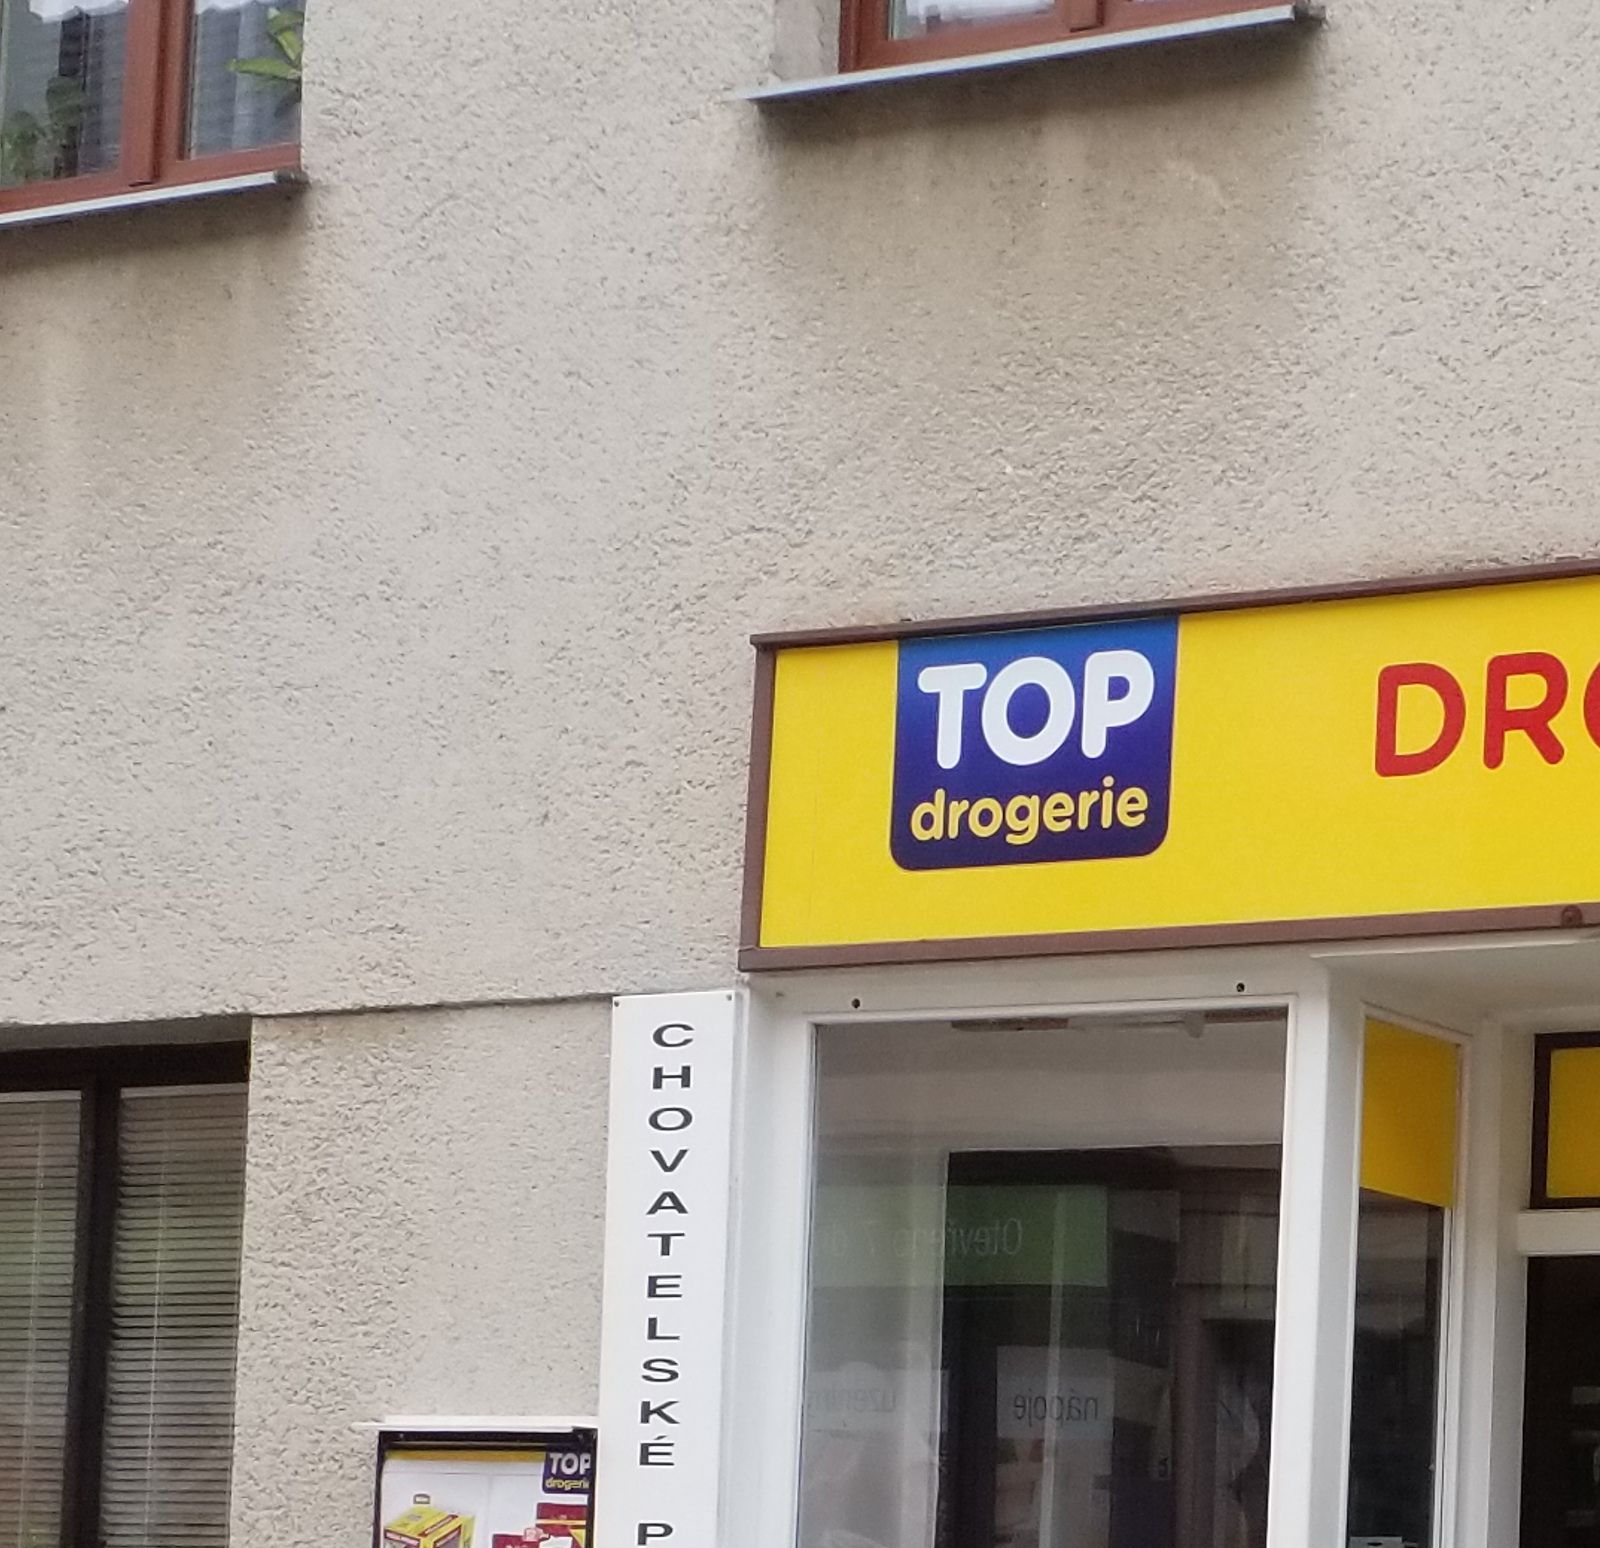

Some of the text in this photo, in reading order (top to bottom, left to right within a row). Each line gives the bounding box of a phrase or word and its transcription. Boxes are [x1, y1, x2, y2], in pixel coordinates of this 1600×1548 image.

[917, 649, 1155, 769] TOP
[911, 776, 1148, 845] drogerie
[639, 1024, 694, 1467] CHOVATELSKÉ
[545, 1477, 590, 1490] drogeri
[549, 1452, 592, 1475] TOP
